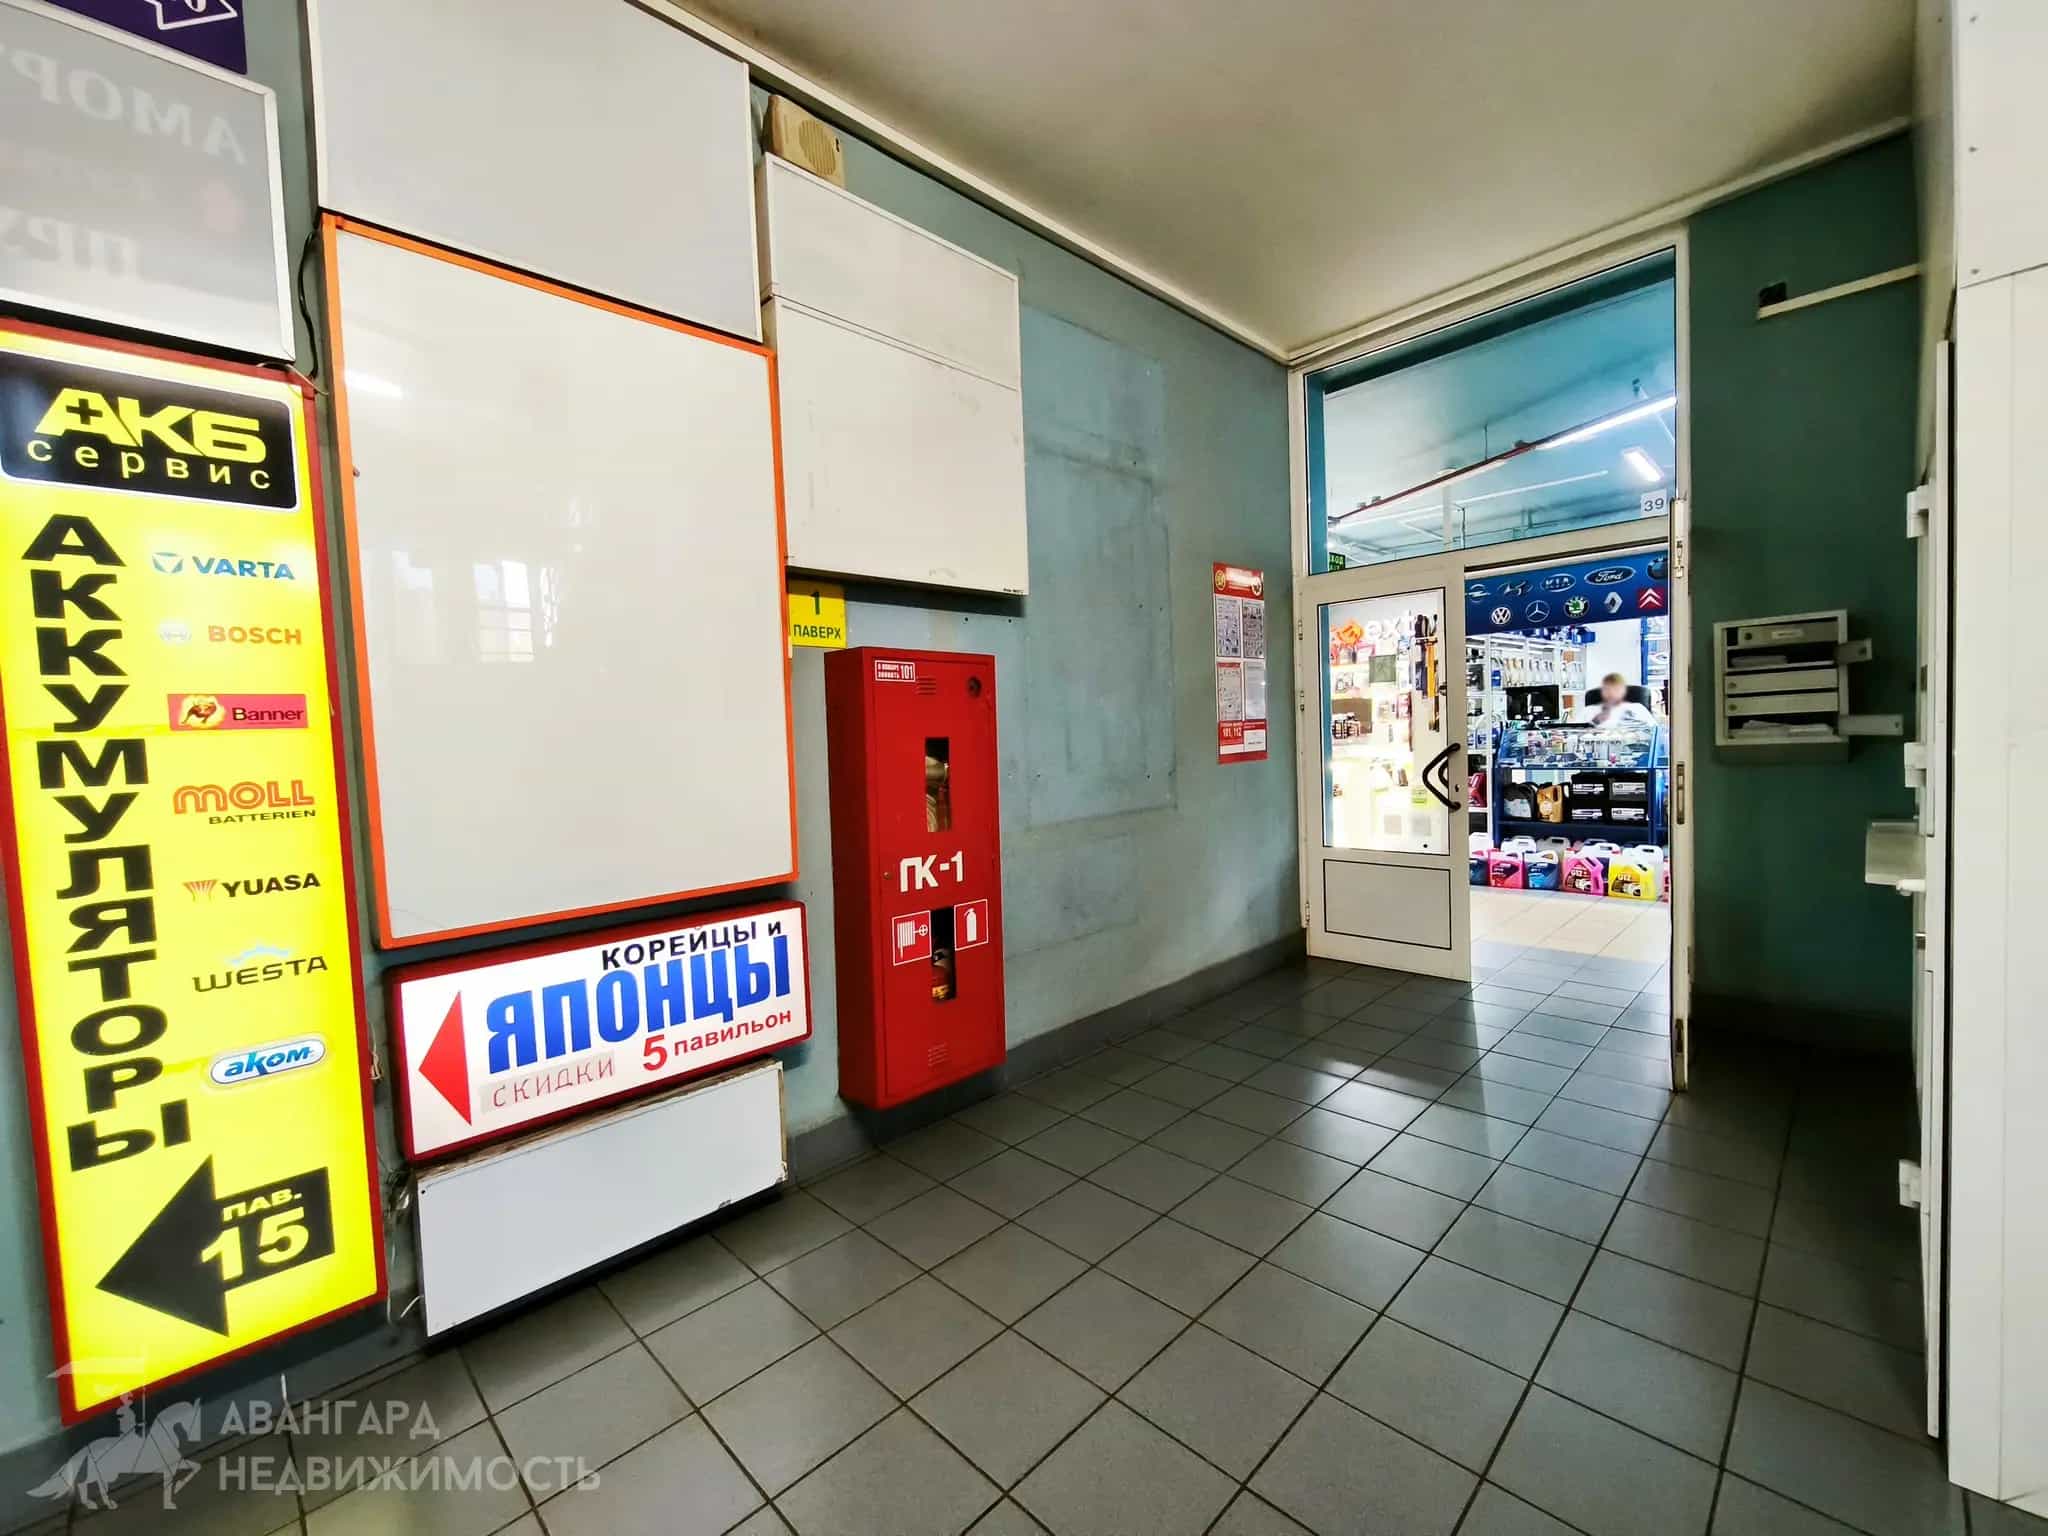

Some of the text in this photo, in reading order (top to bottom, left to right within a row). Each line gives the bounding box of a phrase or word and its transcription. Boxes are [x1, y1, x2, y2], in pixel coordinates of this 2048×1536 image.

[34, 388, 266, 463] АКБ
[27, 440, 270, 489] сервис
[1644, 497, 1664, 512] 39
[192, 555, 296, 580] VARTA
[1595, 570, 1624, 582] Ford
[810, 590, 820, 615] 1
[208, 625, 302, 645] BOSCH
[793, 624, 841, 640] ПАВЕРХ
[900, 665, 913, 679] 101
[232, 707, 305, 721] Banner
[209, 809, 316, 825] BATTERIEN
[21, 513, 191, 1171] АККУМУЛЯТОРЫ
[222, 872, 321, 898] YUASA
[900, 851, 964, 893] ПК-1
[602, 921, 782, 970] КОРЕЙЦЫ и
[192, 955, 328, 993] WESTA
[486, 934, 791, 1074] ЯПОНЦЫ
[643, 1010, 792, 1072] 5 павильон
[492, 1059, 615, 1107] СКИДКИ
[222, 1187, 303, 1221] ПАВ.
[201, 1207, 309, 1280] 15
